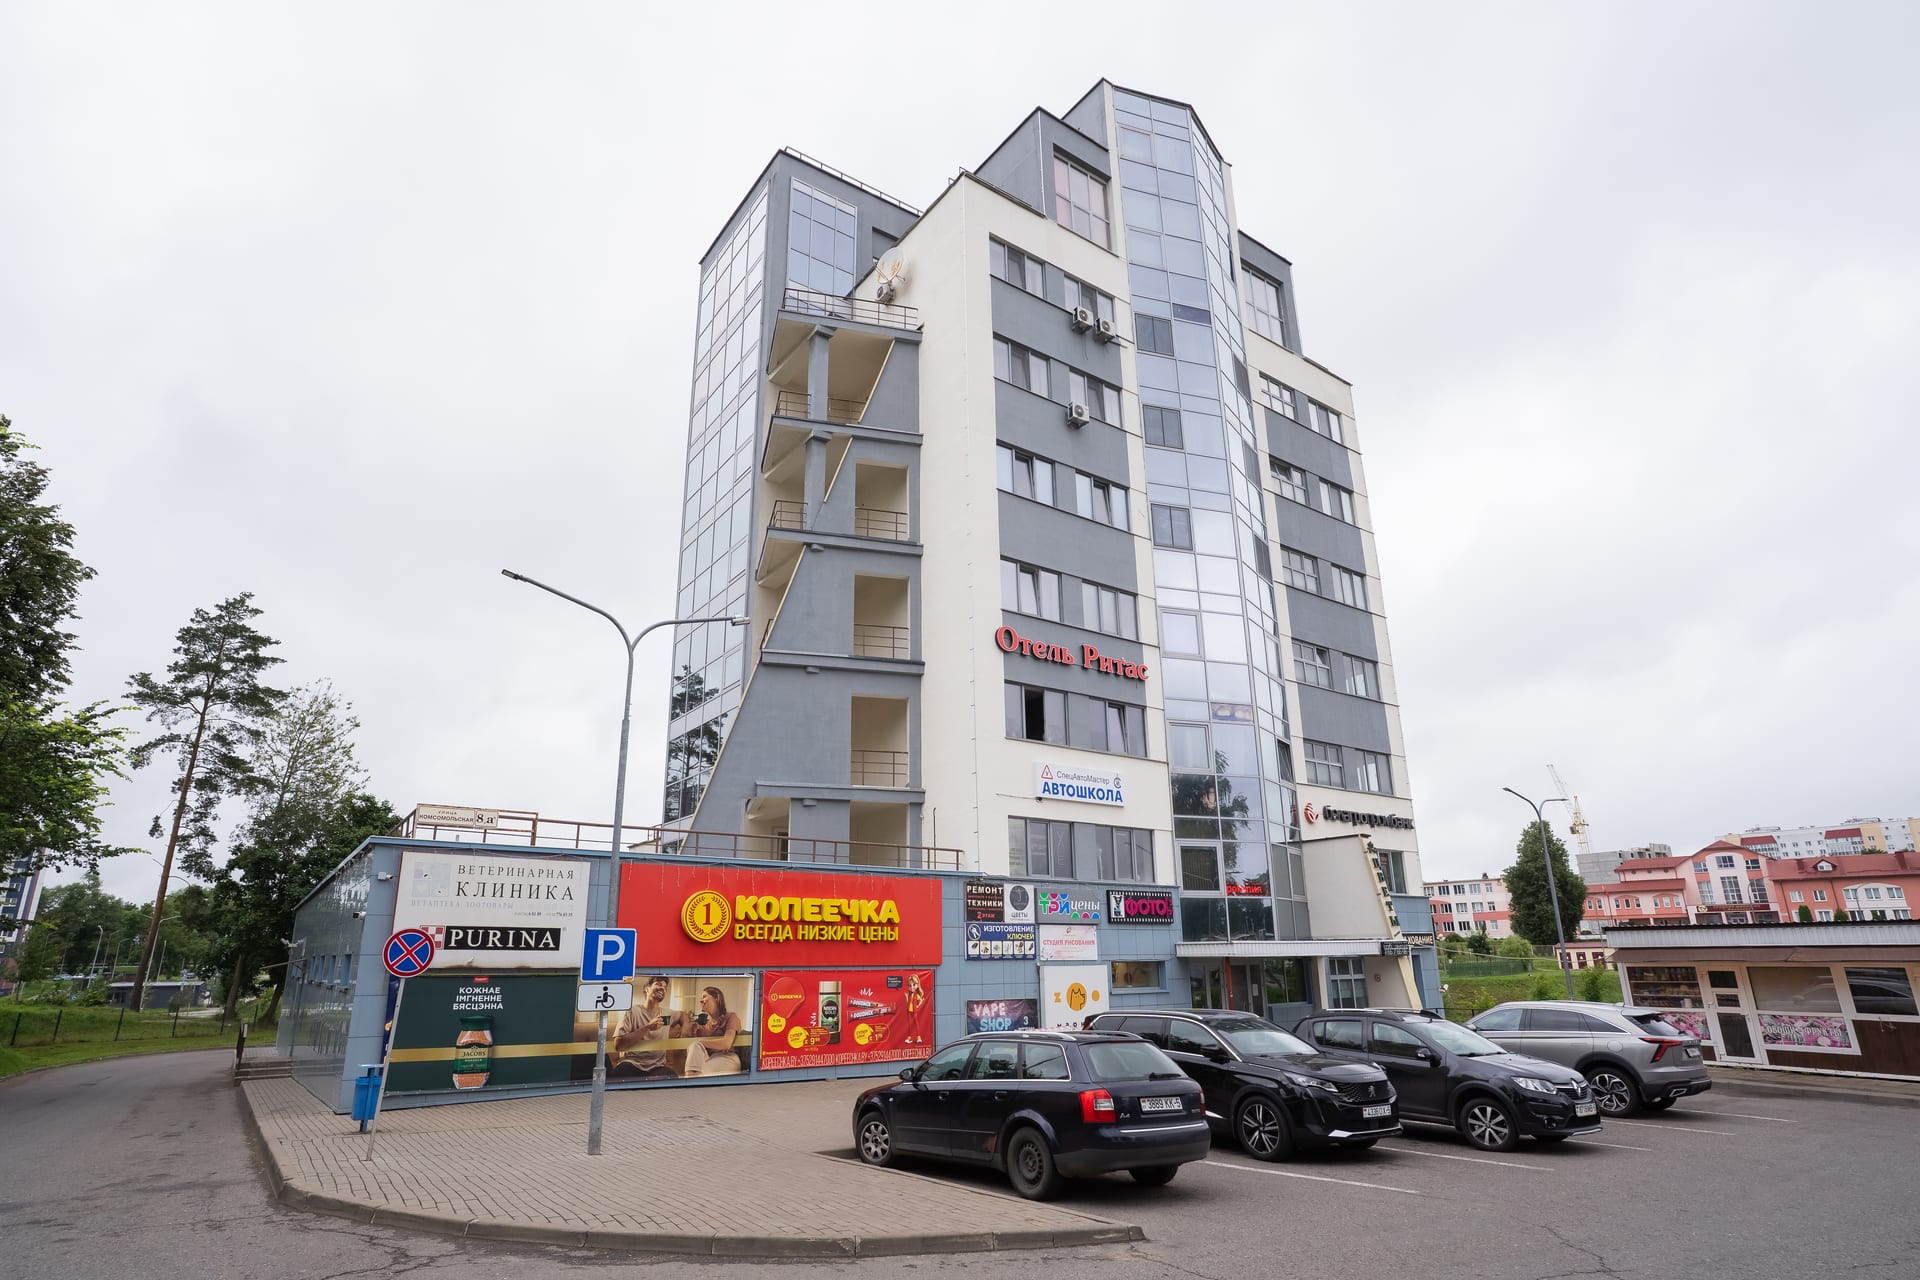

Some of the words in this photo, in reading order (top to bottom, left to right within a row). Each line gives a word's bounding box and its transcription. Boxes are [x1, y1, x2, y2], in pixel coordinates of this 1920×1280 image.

[996, 625, 1075, 665] Отель
[1082, 643, 1150, 681] Ритас
[1056, 770, 1110, 785] СпецАвтоМастер
[1042, 781, 1124, 803] АВТОШКОЛА
[419, 814, 474, 822] КОМСОМОЛЬСКАЯ
[457, 864, 574, 880] ВЕТЕРИНАРНАЯ
[456, 881, 574, 901] КЛИНИКА
[966, 885, 1003, 894] РЕМОНТ
[734, 895, 900, 923] КОПЕЕЧКА
[967, 899, 1003, 907] ТЕХНИКИ
[1039, 899, 1071, 915] ТРИ
[1070, 900, 1100, 911] цены
[1124, 897, 1168, 917] ФОТО
[702, 902, 713, 926] 1
[734, 924, 793, 943] ВСЕГДА
[797, 925, 856, 942] НИЗКИЕ
[859, 926, 899, 944] ЦЕНЫ
[983, 925, 1035, 933] ИЗГОТОВЛЕНИЕ
[1007, 932, 1035, 940] КЛЮЧЕЙ
[448, 928, 556, 948] PURINA
[1404, 935, 1433, 945] ХОВАНИЕ
[596, 934, 625, 976] P
[459, 986, 501, 994] КОЖНАЕ
[453, 1003, 504, 1011] БЯСЦЭННА
[973, 1002, 1007, 1017] VAPE
[980, 1018, 1012, 1031] SHOP
